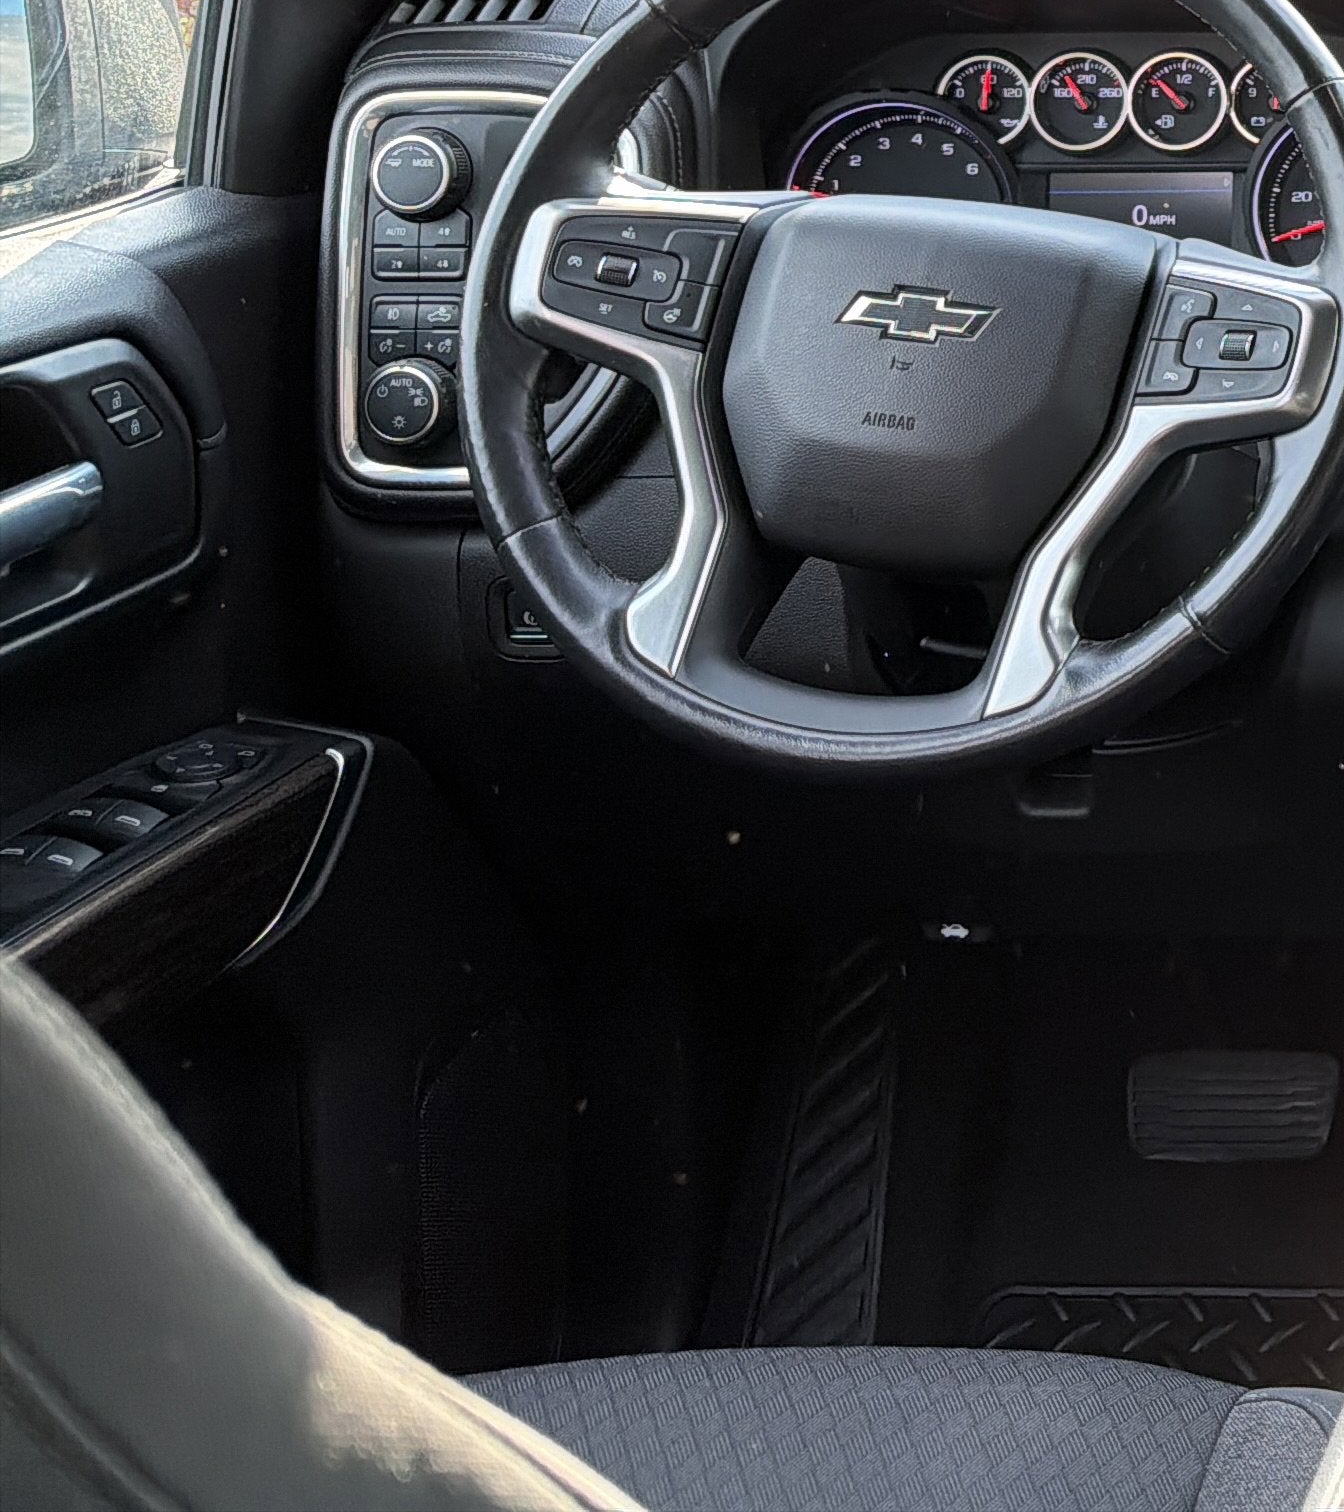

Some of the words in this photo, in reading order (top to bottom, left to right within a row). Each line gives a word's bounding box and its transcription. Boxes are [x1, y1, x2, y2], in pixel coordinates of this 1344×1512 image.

[1077, 74, 1096, 85] 210
[1177, 74, 1193, 85] 1/2
[956, 88, 965, 98] 0
[1002, 88, 1022, 98] 120
[1098, 88, 1121, 98] 260
[1152, 88, 1160, 98] E
[1208, 88, 1216, 98] F
[1248, 88, 1257, 98] 9
[878, 137, 890, 150] 3
[911, 133, 923, 145] 4
[941, 143, 954, 155] 5
[412, 158, 434, 167] MODE
[849, 155, 861, 167] 2
[966, 163, 978, 175] 6
[832, 179, 839, 191] 1
[1291, 191, 1313, 202] 20
[1131, 204, 1148, 226] 0
[1149, 214, 1176, 226] MPH
[385, 228, 407, 236] AUTO
[390, 377, 413, 387] AUTO
[861, 411, 916, 431] AIRBAG
